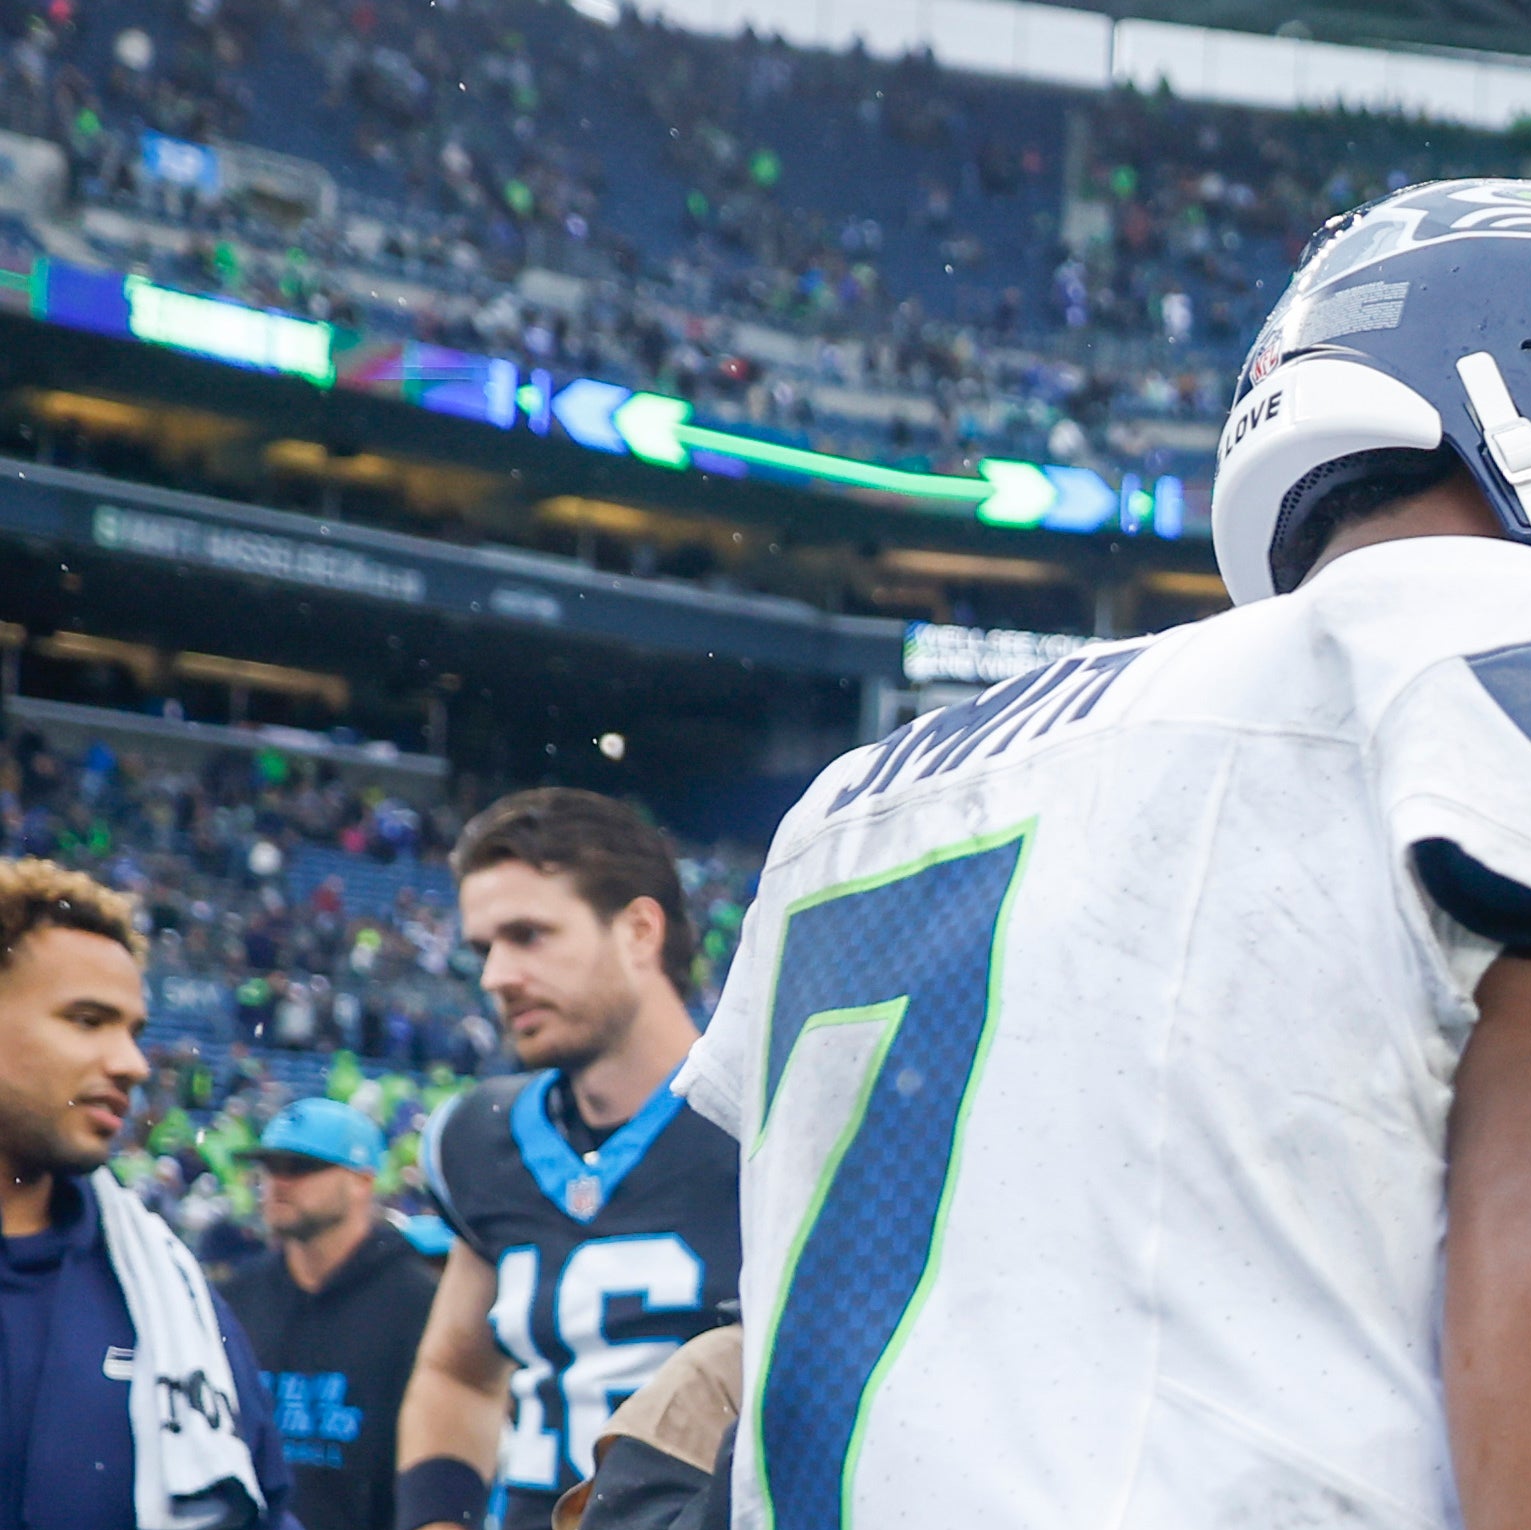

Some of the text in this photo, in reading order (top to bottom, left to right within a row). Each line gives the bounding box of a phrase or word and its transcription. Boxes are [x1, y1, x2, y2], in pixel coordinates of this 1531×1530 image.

[1254, 345, 1279, 381] NFL
[1225, 390, 1283, 458] LOVE
[487, 1231, 706, 1490] 16
